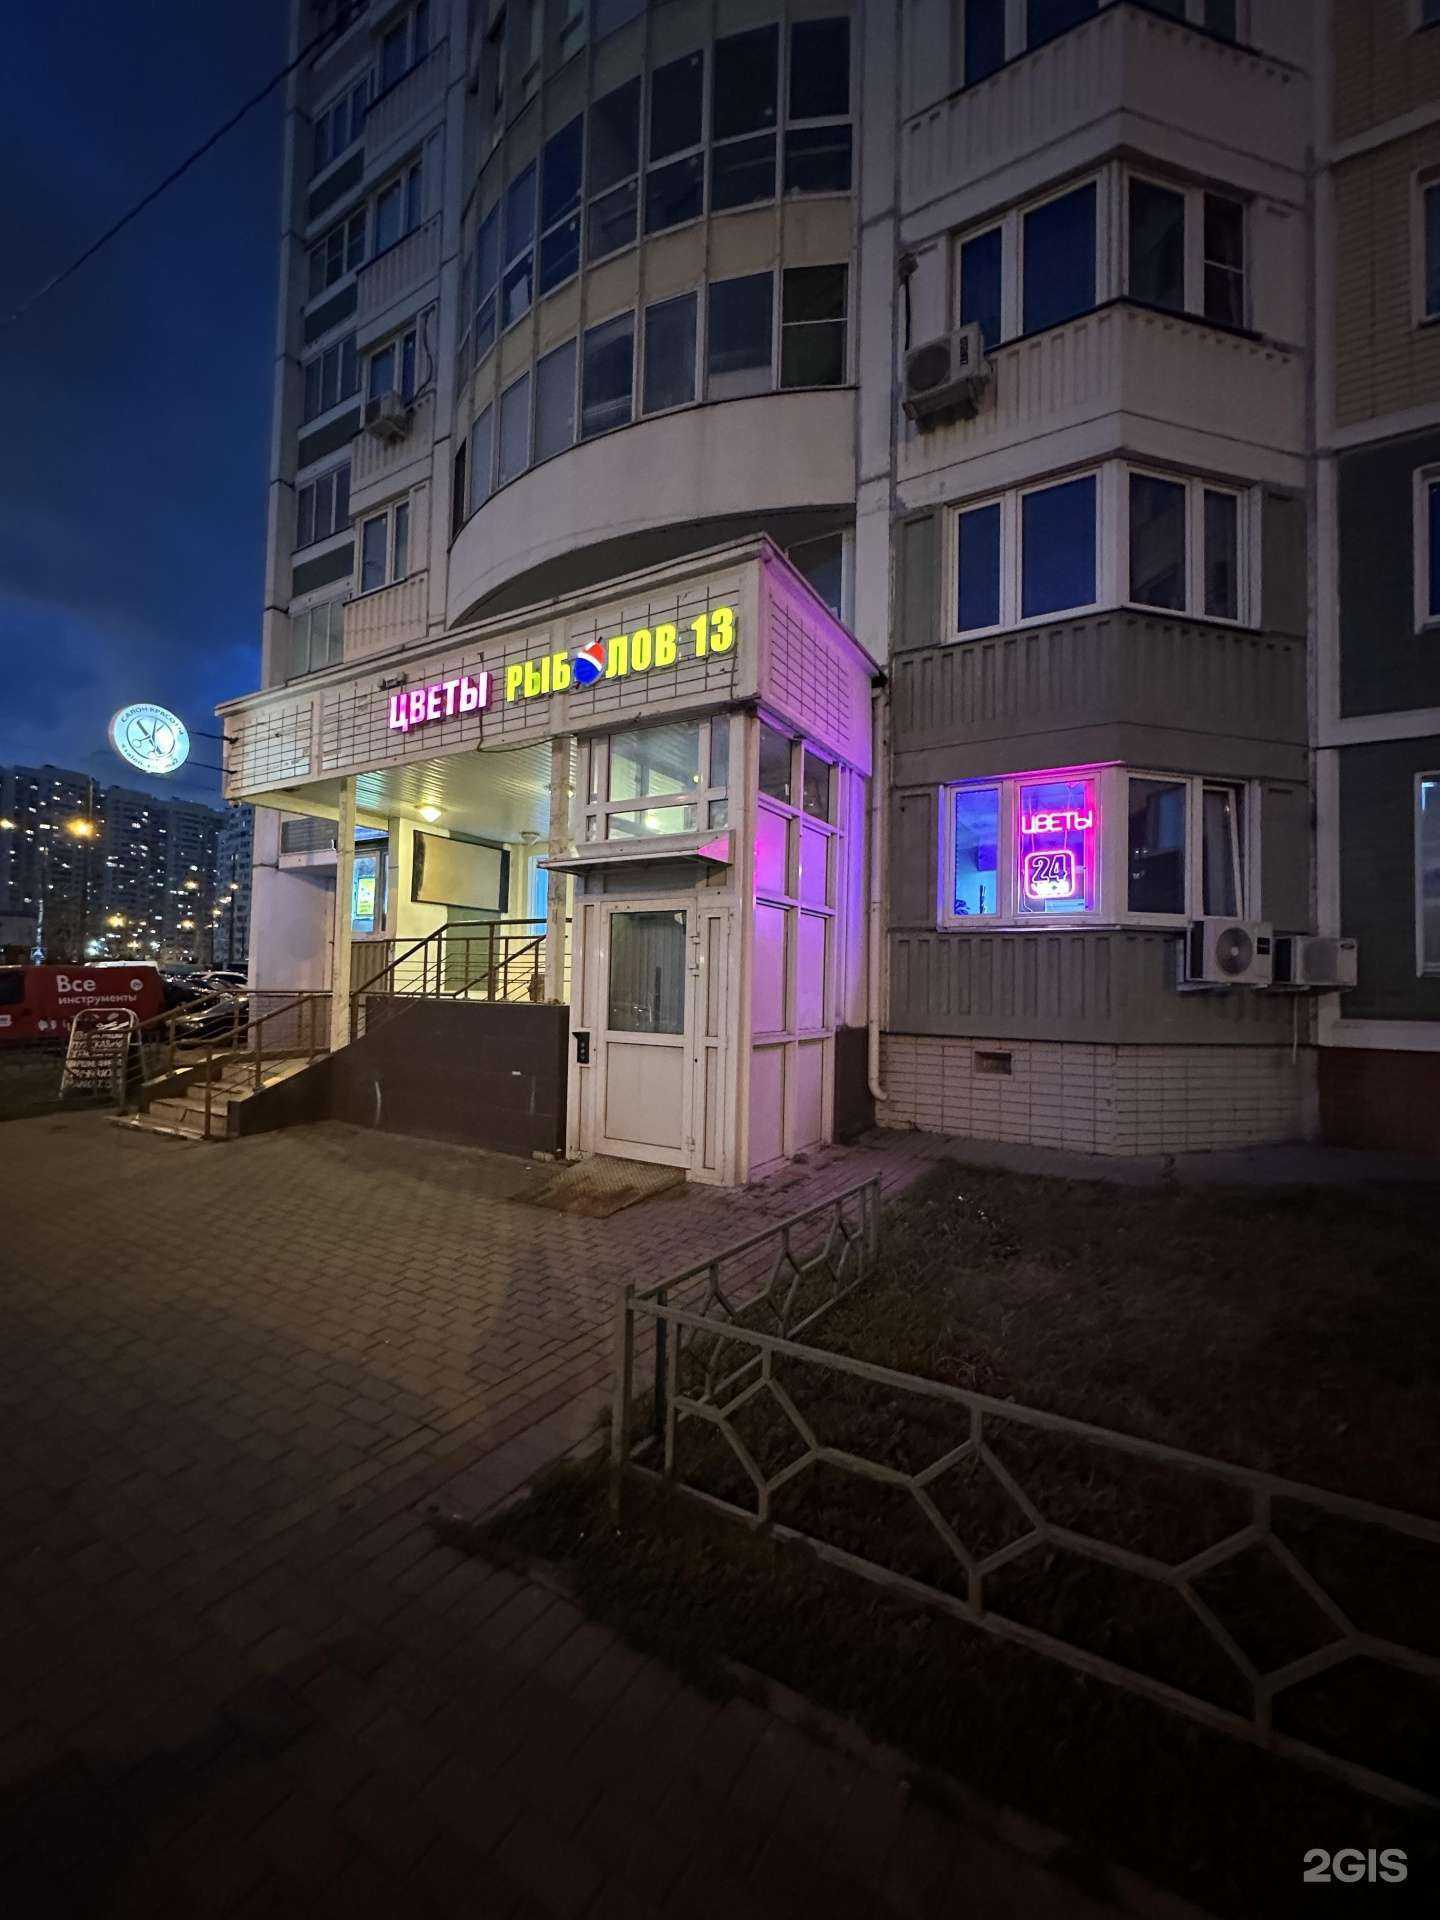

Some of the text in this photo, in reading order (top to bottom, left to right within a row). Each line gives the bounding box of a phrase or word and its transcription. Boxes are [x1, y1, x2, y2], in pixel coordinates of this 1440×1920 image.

[690, 606, 735, 658] 13
[388, 671, 492, 733] ЦВЕТЫ
[1022, 810, 1093, 834] ЦВЕТЫ
[1031, 854, 1068, 882] 24
[57, 974, 97, 993] Все
[58, 994, 138, 1006] инструменты
